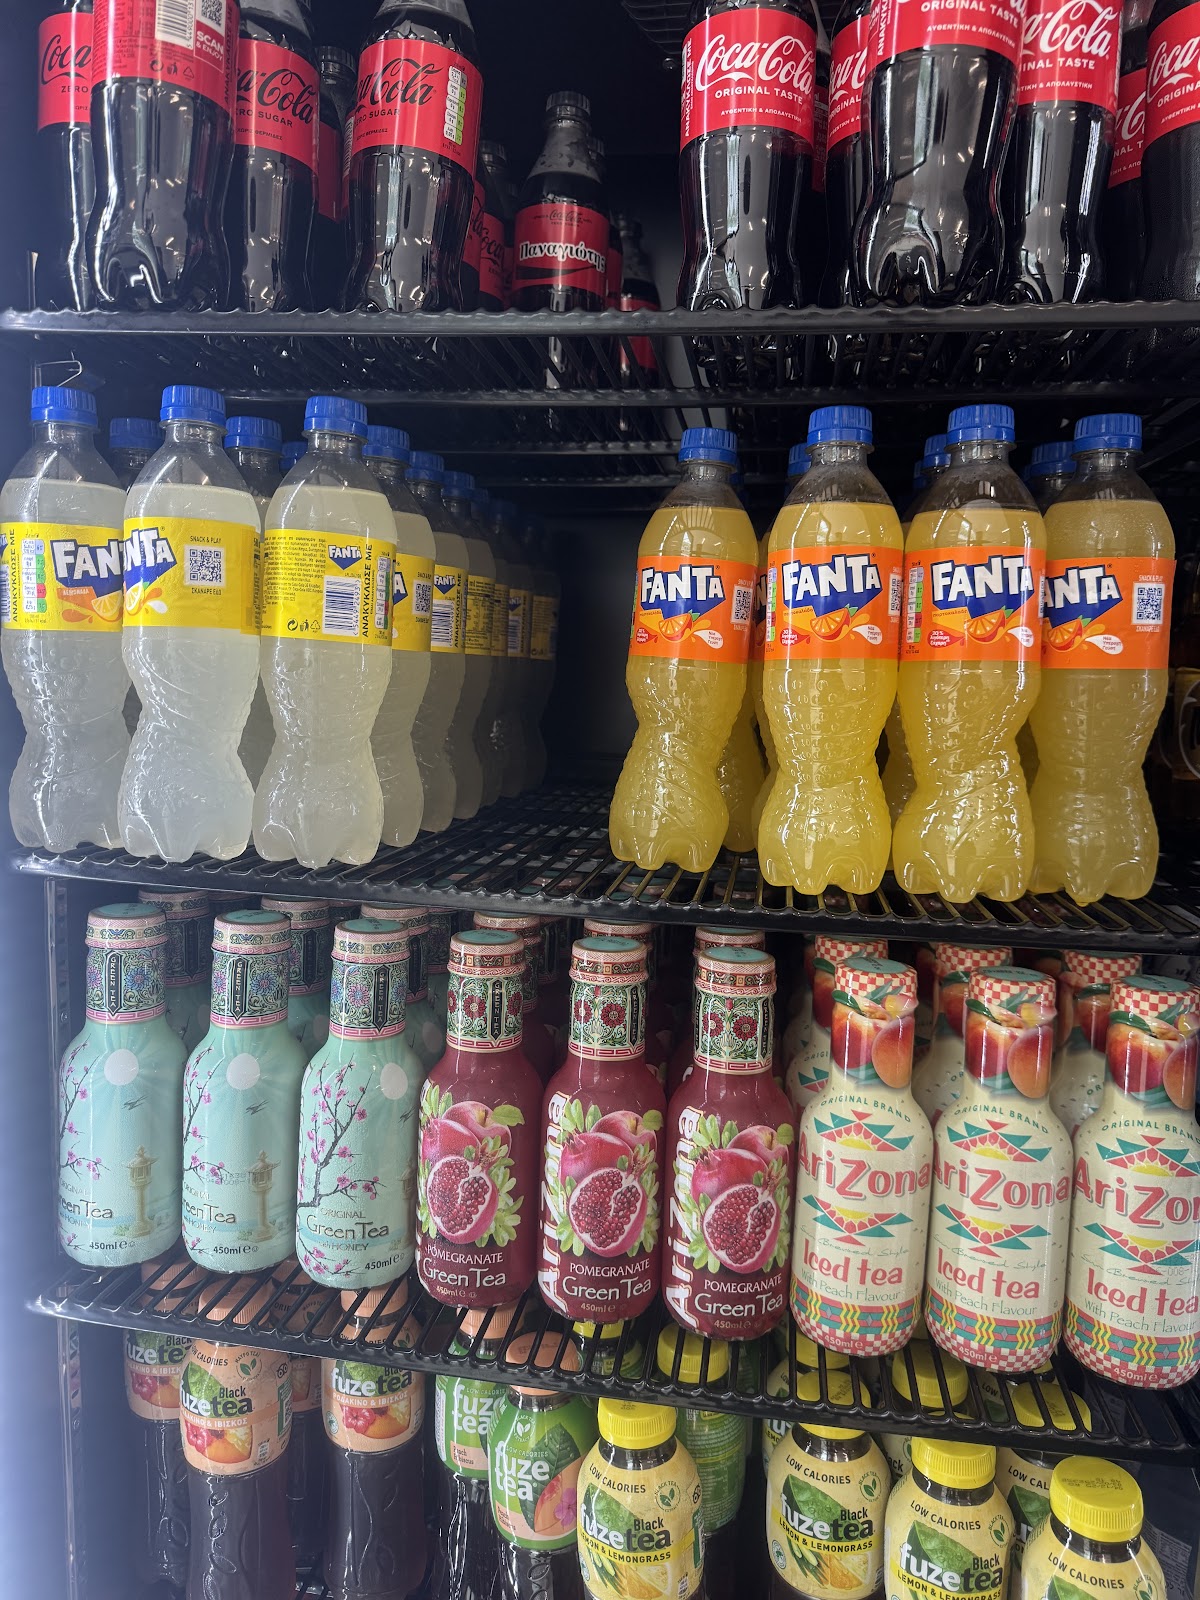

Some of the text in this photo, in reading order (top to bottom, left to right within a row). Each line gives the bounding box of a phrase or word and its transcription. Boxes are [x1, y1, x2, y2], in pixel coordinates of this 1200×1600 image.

[921, 0, 1018, 29] ORIGINAL TASTE
[1023, 0, 1117, 58] a-Cola
[196, 30, 225, 54] SCAN
[695, 34, 816, 95] Coca-Cola
[1057, 57, 1095, 70] TASTE
[236, 68, 317, 124] a-Cola
[715, 85, 803, 105] ORIGINAL TASTE
[1157, 82, 1200, 108] ORIGINA
[258, 111, 293, 127] SUGAR
[369, 108, 400, 118] SUGAR
[519, 241, 606, 273] Παναγιώτης
[123, 529, 175, 571] NTA
[328, 545, 363, 559] FANTA
[641, 566, 724, 604] FANTA
[782, 555, 882, 601] FANTA
[932, 557, 1034, 602] FANTA
[233, 994, 241, 1012] TEA
[376, 970, 386, 1023] GREEN TEA
[820, 1095, 911, 1123] ORIGINAL BRAND
[954, 1104, 1049, 1134] ORIGINAL BRAND
[1102, 1119, 1159, 1131] ORIGINAL
[799, 1130, 932, 1202] AriZona
[79, 1199, 114, 1219] Tea
[203, 1203, 237, 1224] Tea
[320, 1207, 367, 1219] ORIGINAL
[306, 1214, 390, 1240] Green Tea
[89, 1241, 118, 1250] 450ml
[213, 1245, 241, 1255] 450ml
[332, 1242, 369, 1252] HONEY
[427, 1244, 504, 1265] POMEGRANATE
[364, 1257, 393, 1271] 450ml
[423, 1257, 506, 1288] Green Tea
[569, 1257, 650, 1277] POMEGRANATE
[803, 1238, 903, 1287] Iced tea
[937, 1247, 1040, 1299] Iced tea
[562, 1276, 652, 1300] Green Tea
[704, 1272, 783, 1294] POMEGRANATE
[820, 1280, 853, 1300] Peach
[856, 1288, 901, 1302] Flavour
[1087, 1267, 1199, 1317] Iced tea
[580, 1302, 607, 1313] 450ml
[694, 1292, 783, 1317] Green Tea
[955, 1290, 988, 1311] Peach
[992, 1300, 1038, 1316] Flavour
[713, 1319, 743, 1329] 450ml
[1109, 1311, 1149, 1332] Peach
[1153, 1318, 1197, 1334] Flavour
[824, 1335, 853, 1348] 450ml
[196, 1351, 229, 1367] CALORIES
[958, 1346, 987, 1361] 450ml
[1113, 1367, 1147, 1382] 450ml
[219, 1386, 247, 1399] Black
[214, 1417, 248, 1428] ΙΒΙΣΚΟΣ
[495, 1440, 550, 1481] fuze
[518, 1450, 549, 1458] CALORIES
[589, 1463, 647, 1494] LOW CALORIES
[785, 1454, 851, 1485] LOW CALORIES
[1008, 1465, 1028, 1483] LOW
[494, 1466, 534, 1502] tea
[633, 1517, 664, 1532] Black
[840, 1506, 869, 1521] Black
[910, 1500, 982, 1531] LOW CALORIES
[779, 1518, 874, 1553] LEMON & LEMONGRASS
[601, 1546, 607, 1554] &
[608, 1549, 671, 1564] LEMONGRASS
[973, 1553, 1000, 1571] Black
[1048, 1552, 1125, 1589] LOW CALORIES
[897, 1569, 937, 1597] LEMON &
